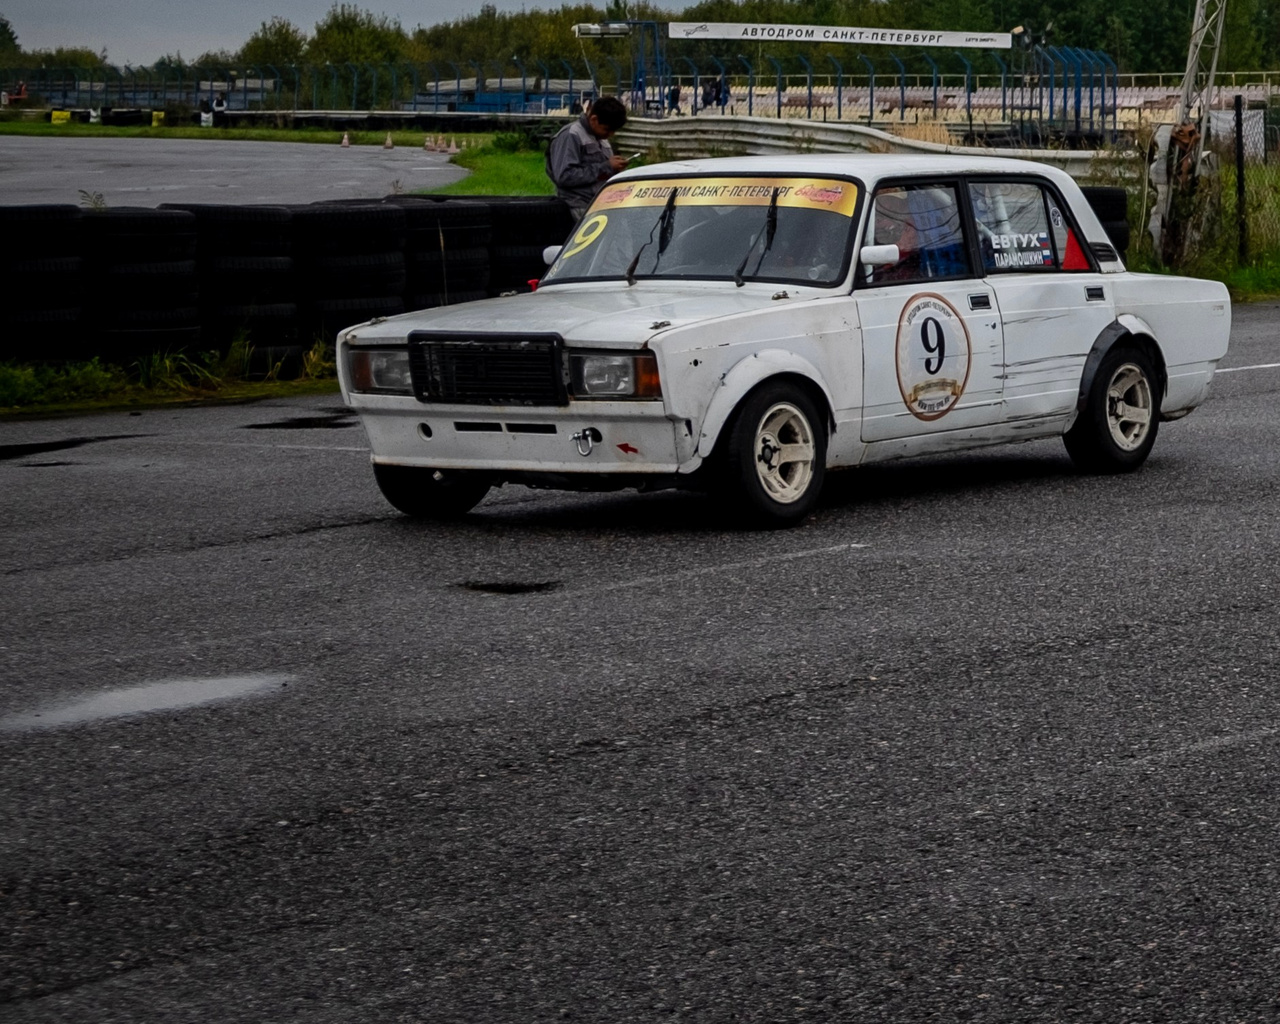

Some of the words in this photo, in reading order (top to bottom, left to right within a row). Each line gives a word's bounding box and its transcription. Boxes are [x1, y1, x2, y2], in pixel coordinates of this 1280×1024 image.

[741, 27, 815, 38] АВТОДРОМ
[822, 29, 943, 44] САНКТ-ПЕТЕРБУРГ
[691, 185, 794, 197] САНКТ-ПЕТЕРБРГ
[562, 214, 608, 259] 9
[991, 233, 1041, 249] ЕВТУХ
[994, 251, 1044, 267] ПАРАМОШКИН
[920, 316, 946, 375] 9
